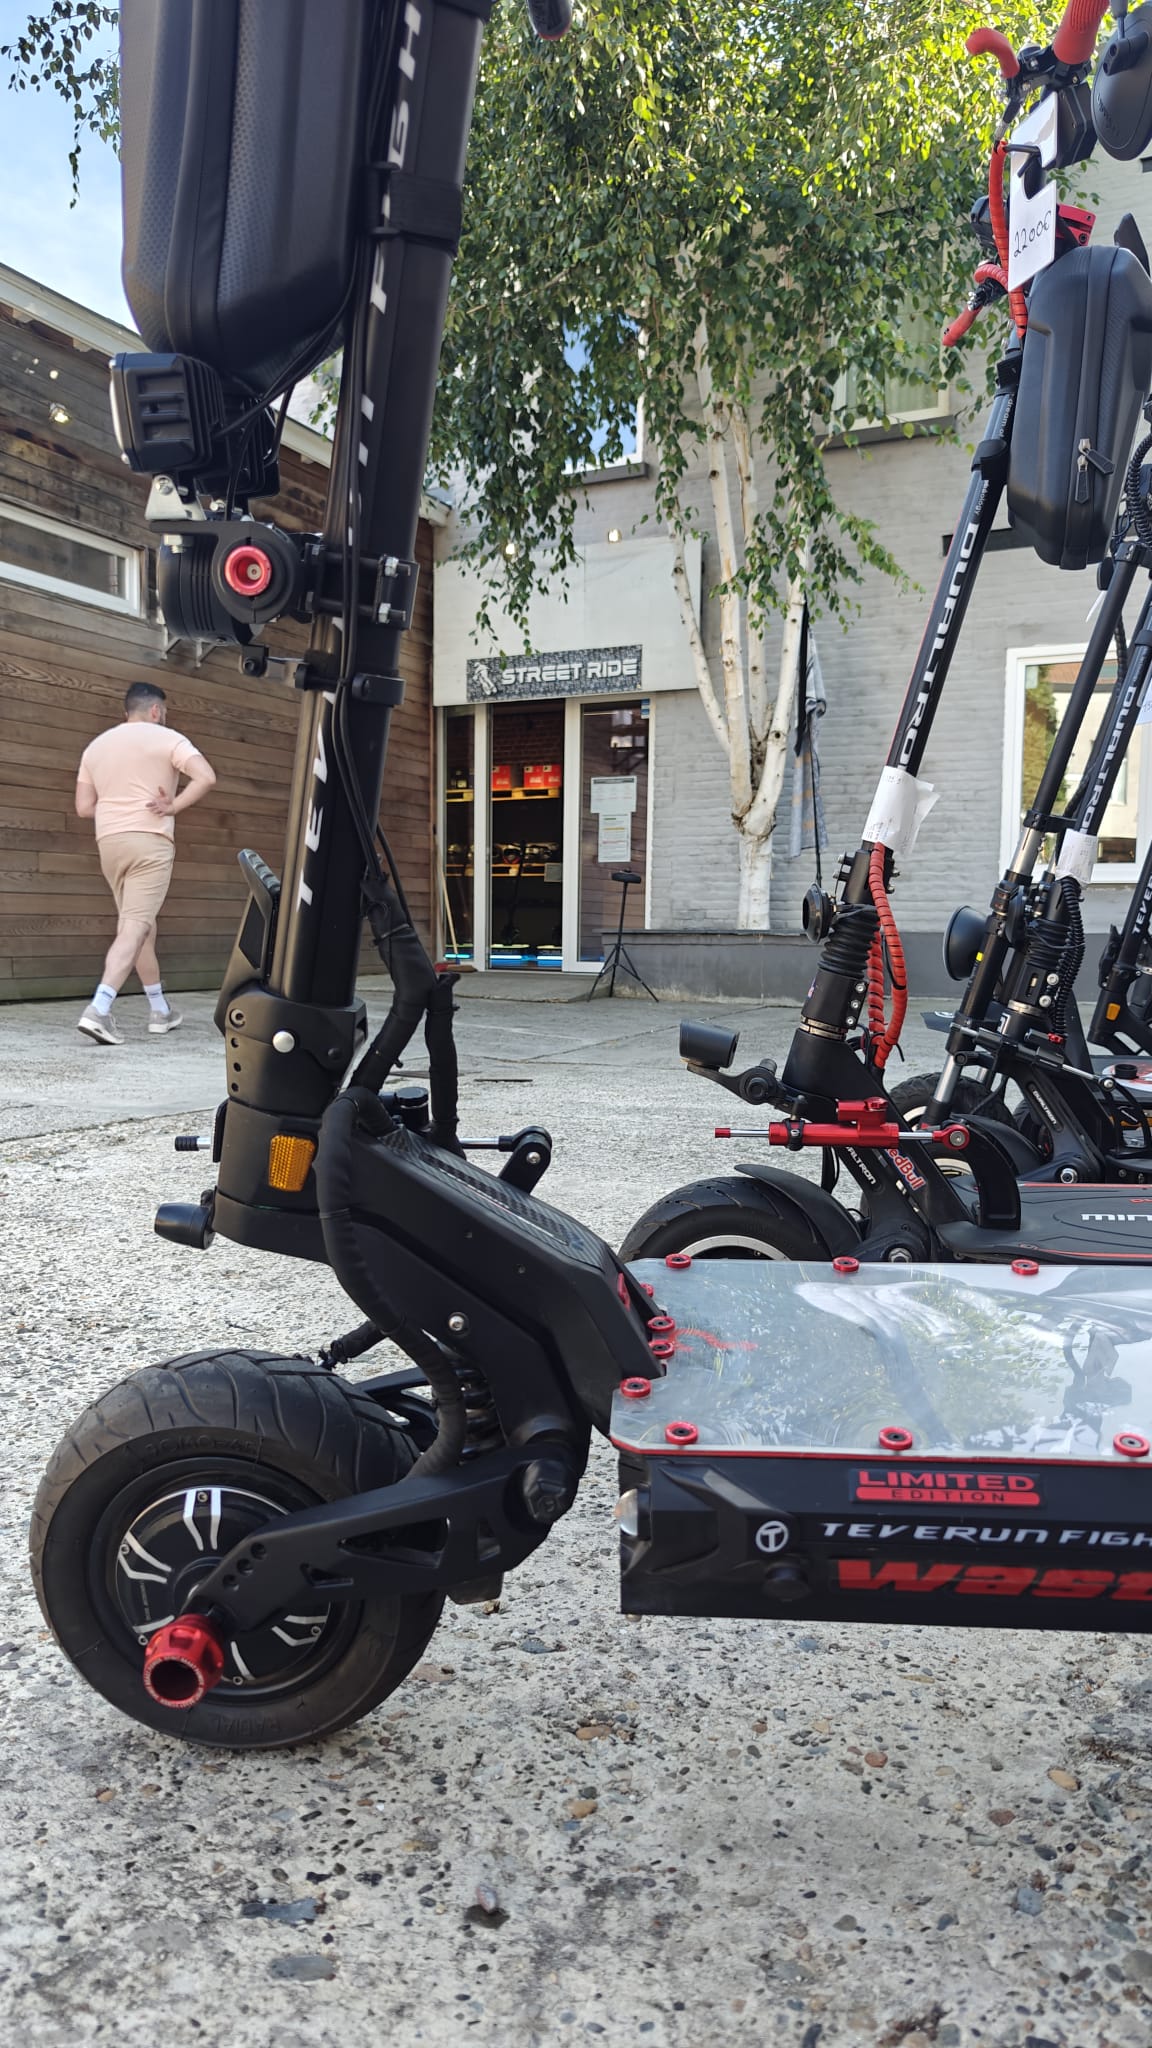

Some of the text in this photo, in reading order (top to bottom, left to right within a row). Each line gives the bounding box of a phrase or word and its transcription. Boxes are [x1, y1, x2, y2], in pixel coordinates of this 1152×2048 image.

[896, 521, 980, 771] DUALTRO
[501, 658, 638, 686] STREET RIDE
[1079, 685, 1138, 835] DUALTRO
[845, 1146, 877, 1185] ALTRON
[883, 1147, 926, 1191] edBull
[858, 1470, 1036, 1491] LIMITED
[890, 1488, 1006, 1503] EDITION
[820, 1522, 1050, 1544] TEVERUN
